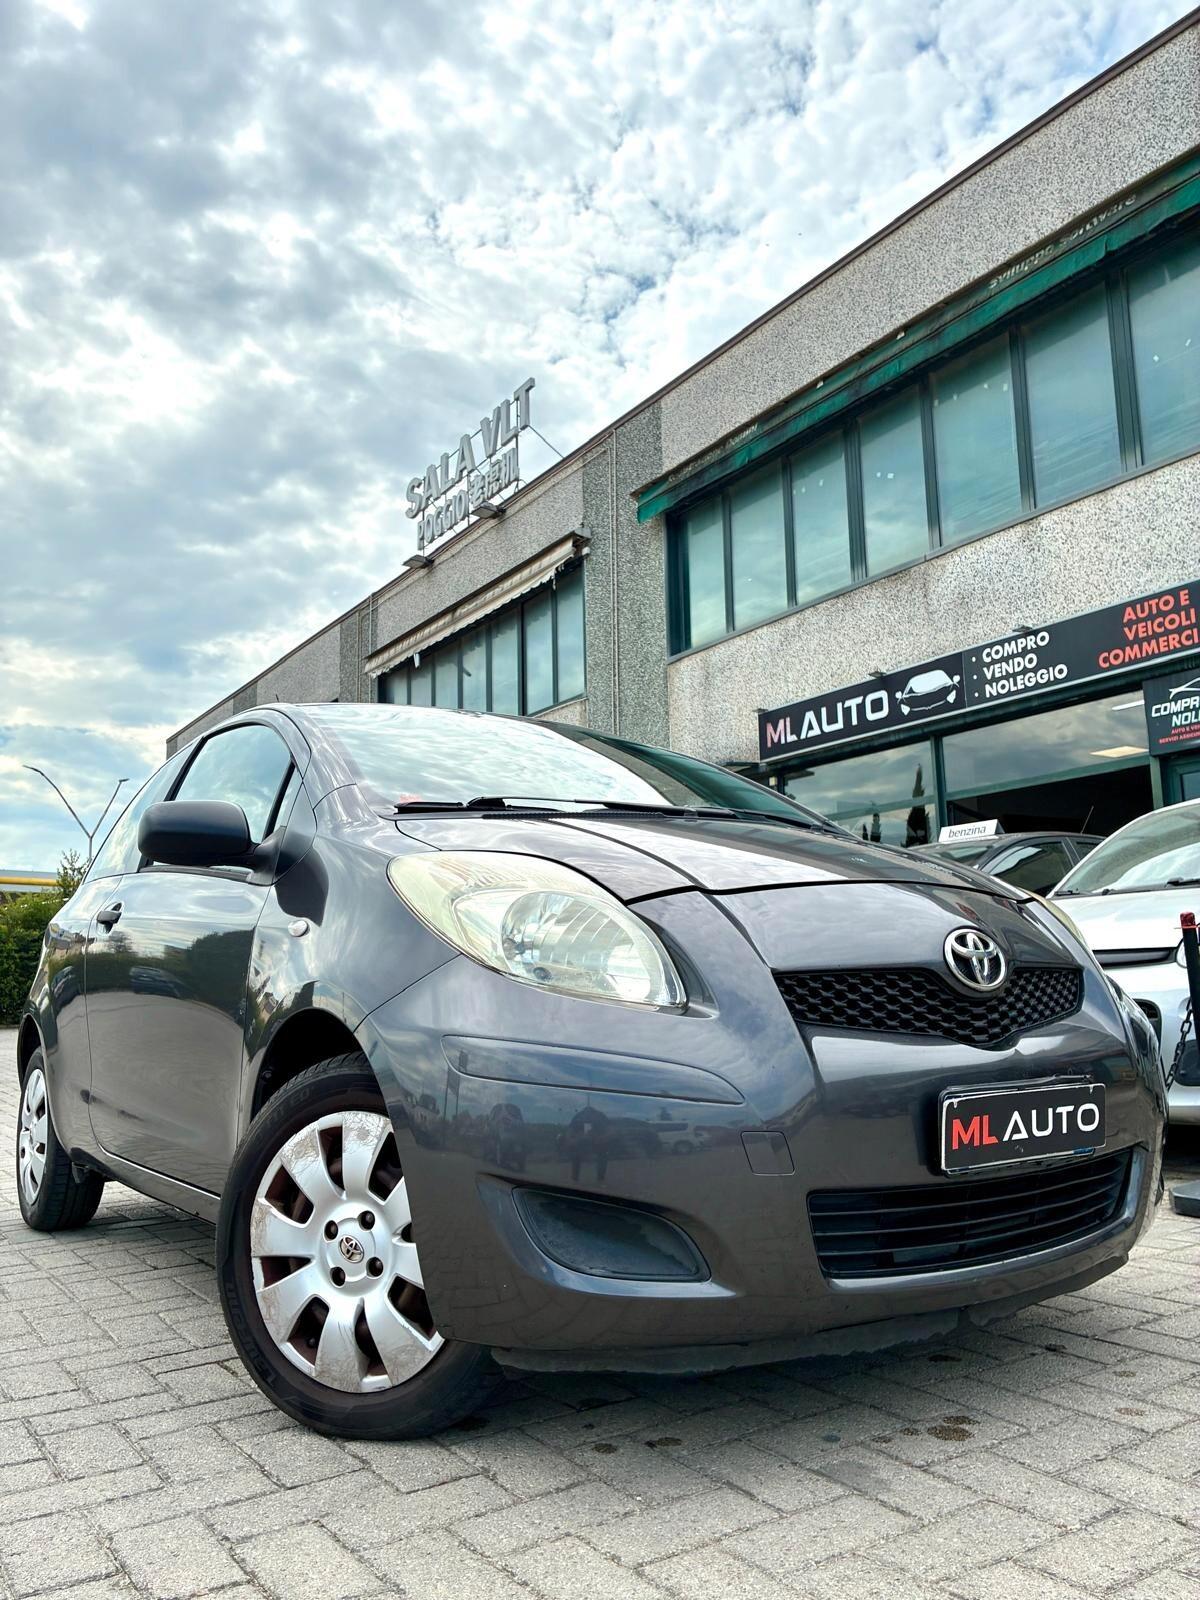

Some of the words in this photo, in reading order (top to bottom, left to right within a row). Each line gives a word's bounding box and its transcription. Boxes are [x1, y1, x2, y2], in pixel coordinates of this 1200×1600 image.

[405, 433, 476, 519] SALA
[480, 376, 536, 459] VLT
[417, 489, 470, 551] POGGIO
[1123, 594, 1175, 623] AUTO
[1179, 589, 1190, 606] E
[1123, 607, 1196, 641] VEICOLI
[982, 631, 1050, 663] COMPRO
[1098, 628, 1199, 668] COMMERCI
[982, 652, 1038, 680] VENDO
[984, 663, 1068, 698] NOLEGGIO
[1151, 695, 1200, 718] COMPR
[1171, 709, 1200, 727] NOL
[948, 825, 987, 838] benzina
[1002, 1102, 1100, 1142] AUTO
